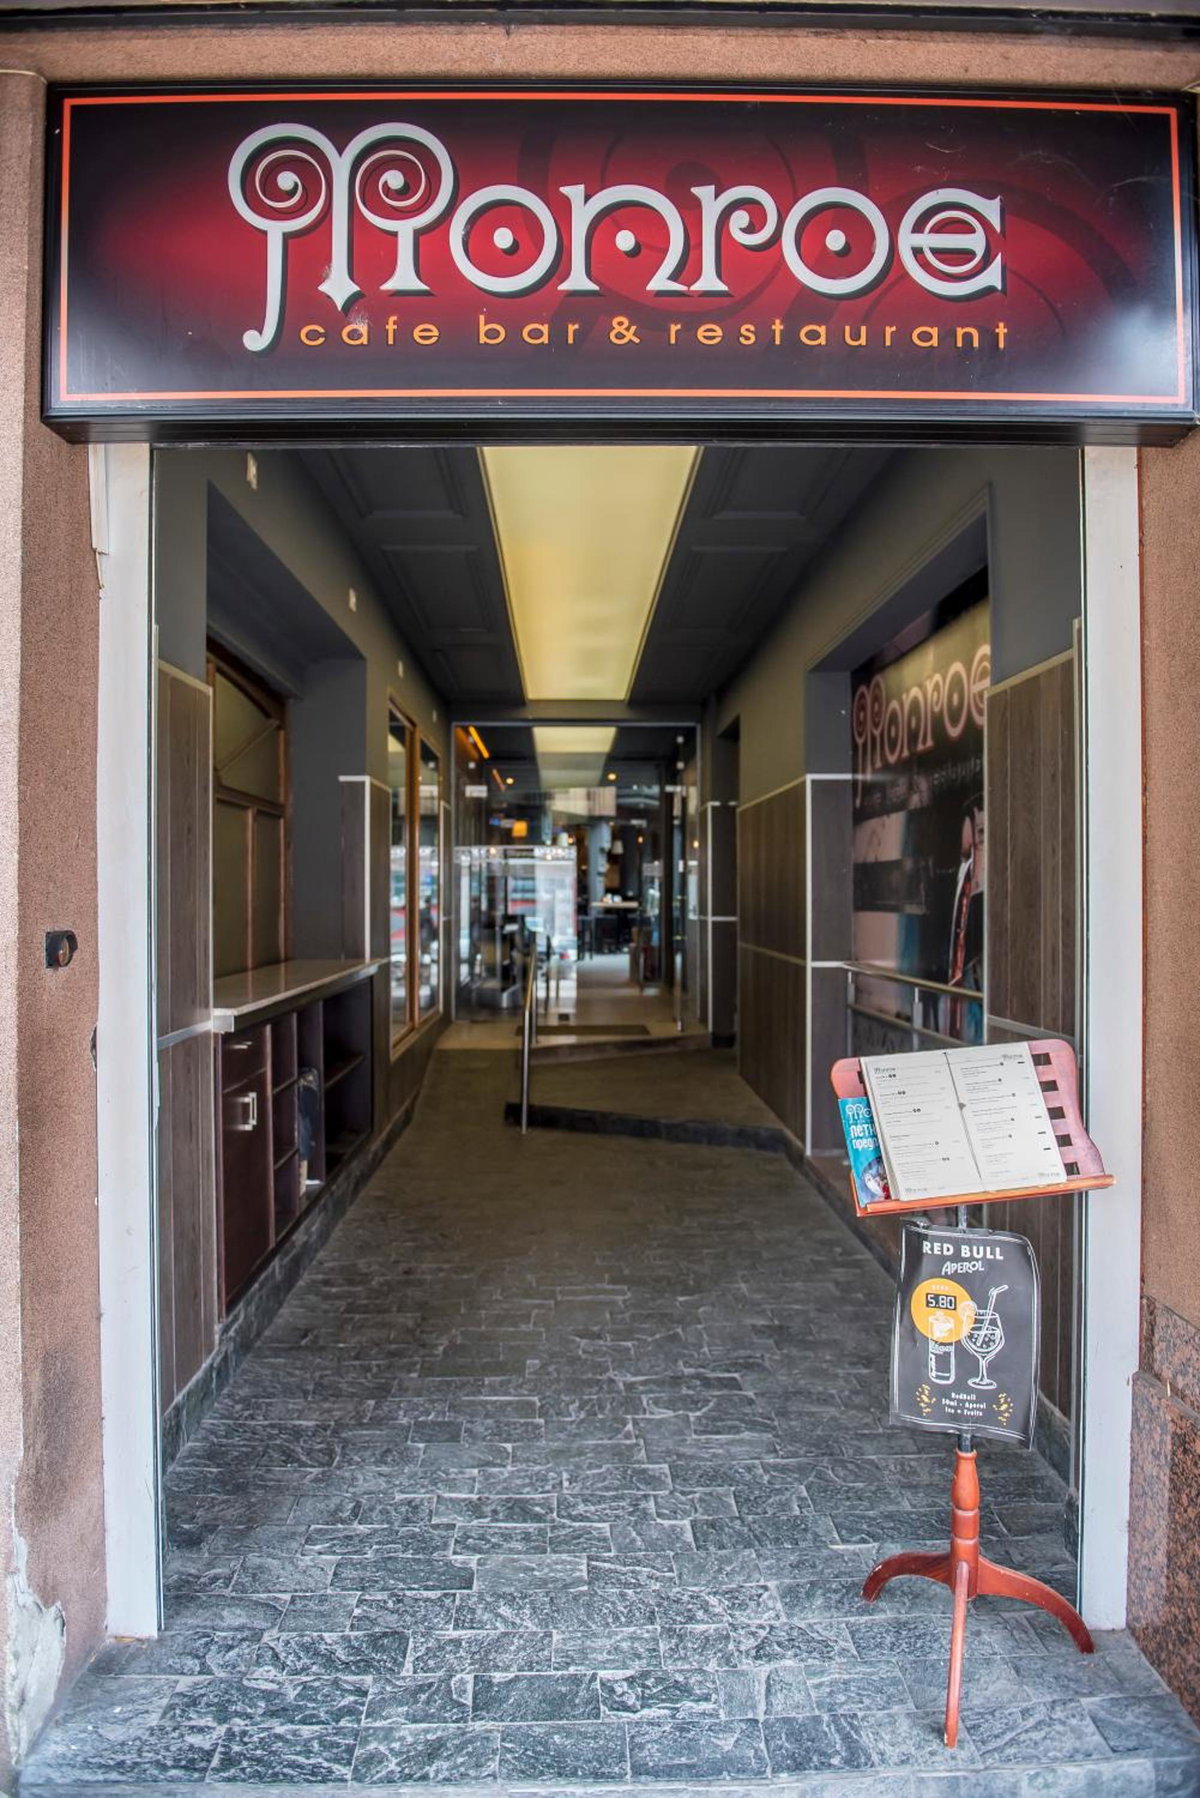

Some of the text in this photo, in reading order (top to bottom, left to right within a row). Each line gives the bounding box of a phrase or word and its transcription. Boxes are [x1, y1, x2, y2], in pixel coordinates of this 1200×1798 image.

[228, 122, 1002, 352] Monroe
[299, 314, 1008, 349] cafe bar & restaurant
[922, 1240, 1004, 1260] RED BULL
[941, 1260, 985, 1275] APEROL
[927, 1294, 955, 1309] 5.80
